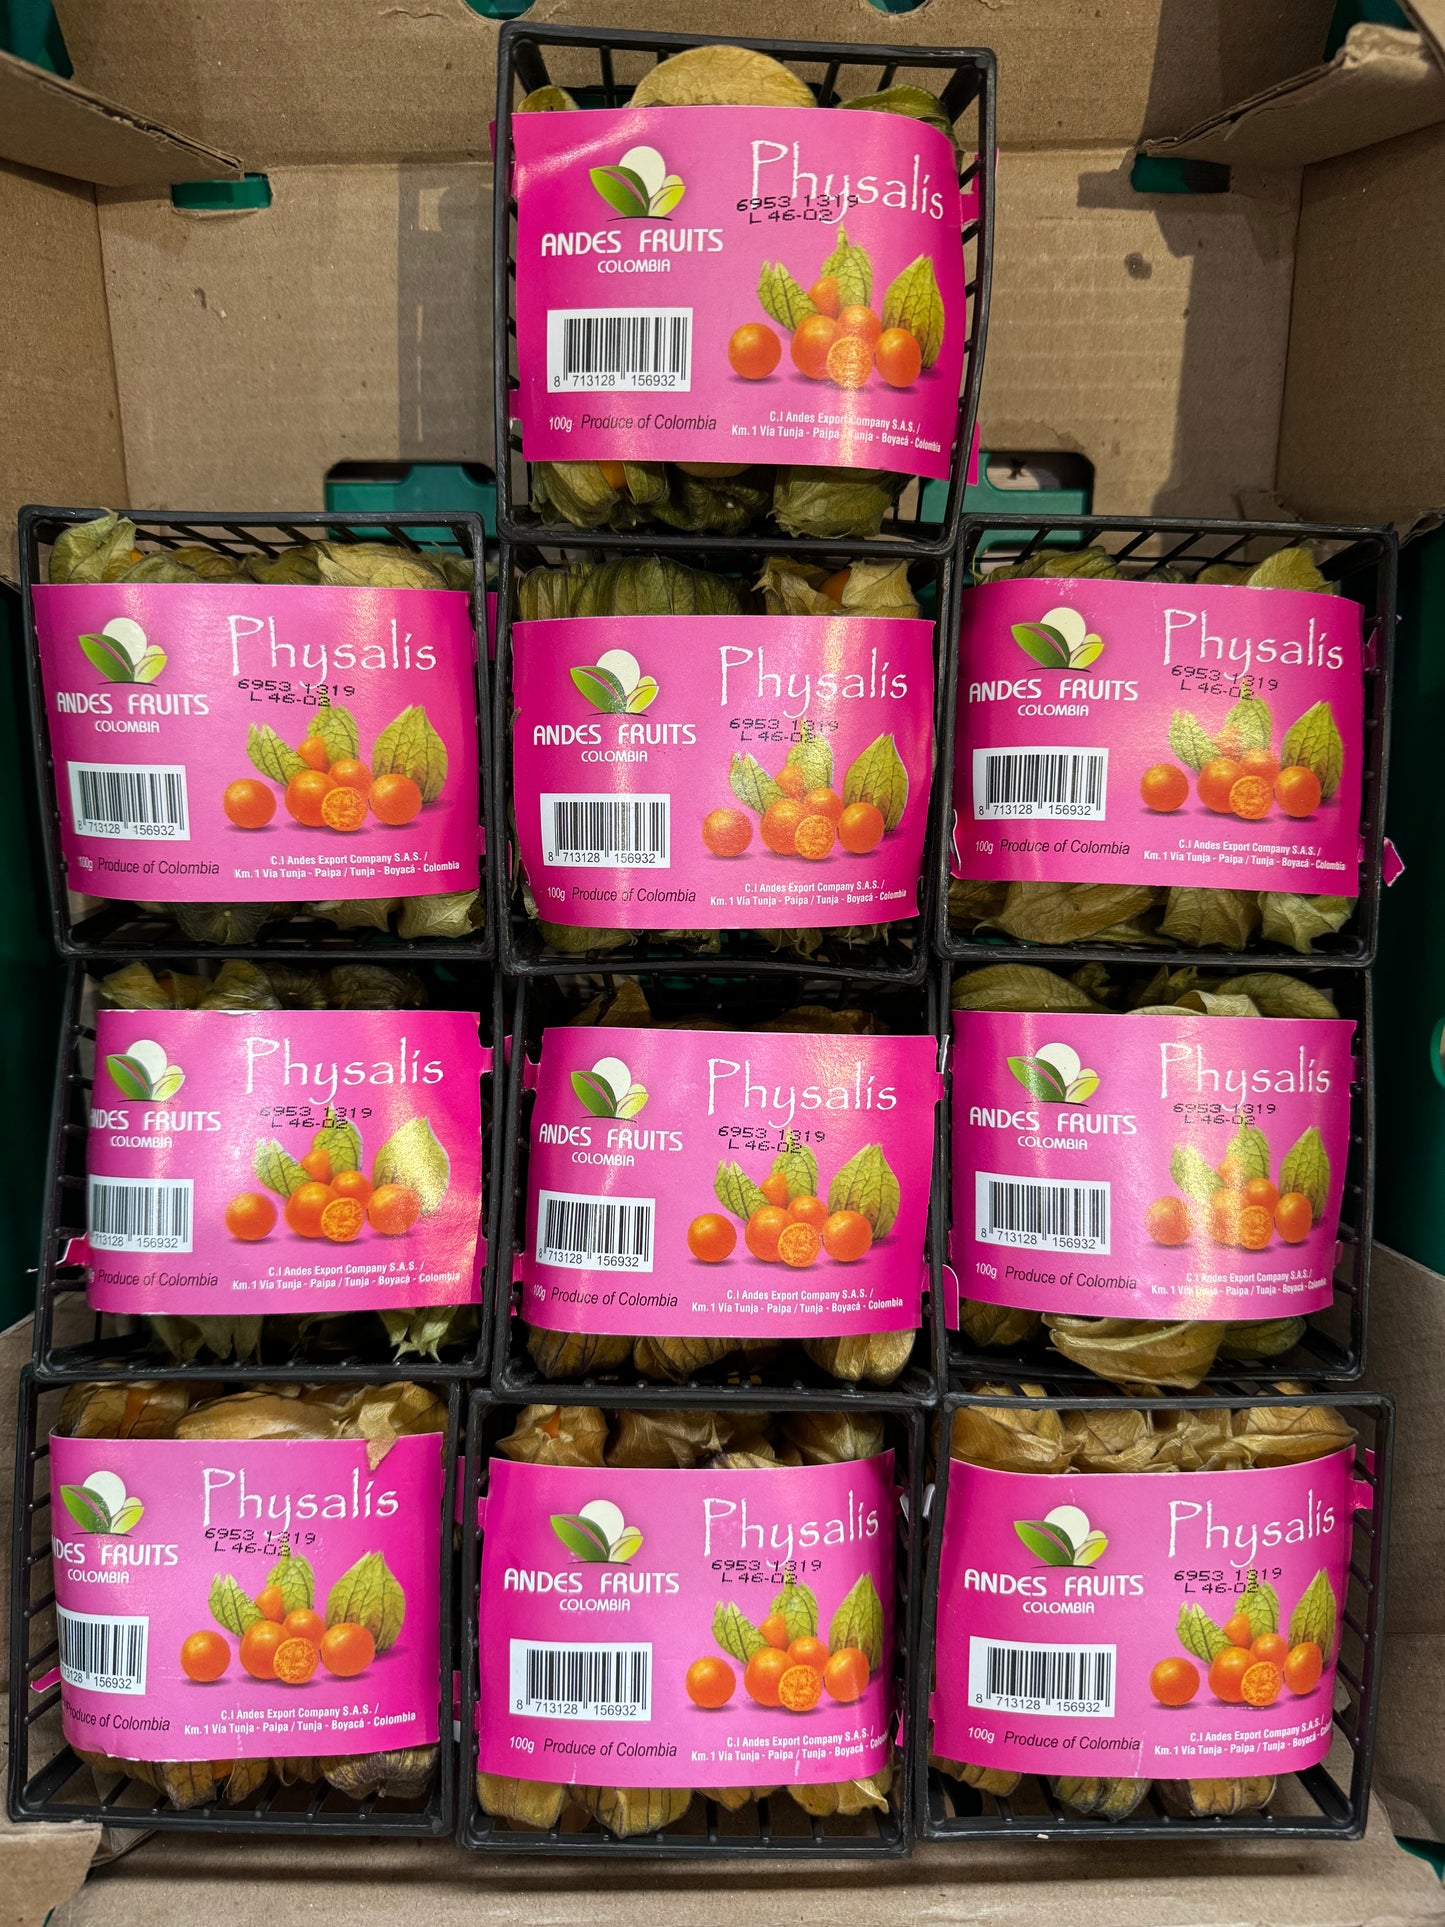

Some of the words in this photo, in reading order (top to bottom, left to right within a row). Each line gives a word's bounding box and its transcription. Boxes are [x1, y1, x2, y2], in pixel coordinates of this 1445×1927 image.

[737, 196, 791, 211] 6953
[803, 195, 859, 208] 1319
[750, 213, 761, 224] L
[768, 209, 833, 222] 46-02
[541, 231, 621, 256] ANDES
[639, 229, 723, 253] FRUITS
[598, 260, 671, 273] COLOMBIA
[573, 374, 615, 387] 713128
[632, 374, 676, 386] 156932
[548, 417, 572, 432] 100g
[581, 415, 633, 431] Produce
[637, 415, 651, 429] of
[654, 414, 717, 431] Colombia
[1171, 665, 1220, 681] 6953
[1232, 674, 1279, 690] 1319
[238, 679, 291, 691] 6953
[305, 684, 355, 696] 1319
[969, 679, 1042, 703] ANDES
[1060, 678, 1138, 701] FRUITS
[1180, 679, 1191, 690] L
[1198, 682, 1254, 700] 46-02
[57, 693, 112, 714] ANDES
[128, 694, 209, 715] FRUITS
[250, 692, 263, 702] L
[1017, 705, 1089, 717] COLOMBIA
[95, 721, 160, 733] COLOMBIA
[729, 719, 780, 730] 6953
[533, 726, 601, 746] ANDES
[618, 723, 697, 744] FRUITS
[740, 730, 751, 741] L
[581, 750, 648, 762] COLOMBIA
[993, 803, 1033, 816] 713128
[1048, 804, 1091, 816] 156932
[88, 822, 120, 834] 713128
[133, 824, 175, 836] 156932
[1000, 839, 1050, 854] Produce
[1054, 839, 1067, 852] of
[1070, 839, 1130, 855] Colombia
[288, 854, 315, 864] Andes
[319, 854, 347, 866] Export
[351, 853, 392, 865] Company
[395, 852, 421, 863] S.A.S.
[563, 851, 600, 863] 713128
[614, 852, 656, 863] 156932
[98, 858, 140, 874] Produce
[144, 859, 155, 873] of
[159, 860, 219, 874] Colombia
[547, 887, 565, 902] 100g
[572, 888, 618, 902] Produce
[621, 888, 633, 901] of
[637, 888, 696, 902] Colombia
[144, 1109, 221, 1131] FRUITS
[324, 1106, 373, 1119] 1319
[969, 1106, 1039, 1130] ANDES
[1057, 1113, 1137, 1134] FRUITS
[539, 1124, 591, 1147] ANDES
[607, 1129, 683, 1151] FRUITS
[718, 1126, 767, 1138] 6953
[779, 1129, 825, 1142] 1319
[111, 1136, 172, 1148] COLOMBIA
[728, 1139, 739, 1150] L
[745, 1140, 801, 1154] 46-02
[1017, 1136, 1088, 1150] COLOMBIA
[572, 1152, 634, 1166] COLOMBIA
[137, 1236, 178, 1248] 156932
[997, 1230, 1038, 1245] 713128
[1052, 1235, 1096, 1250] 156932
[548, 1251, 582, 1265] 713128
[597, 1254, 639, 1267] 156932
[99, 1270, 140, 1286] Produce
[143, 1272, 156, 1286] of
[158, 1271, 218, 1287] Colombia
[1005, 1266, 1056, 1286] Produce
[1059, 1271, 1073, 1287] of
[1076, 1272, 1137, 1290] Colombia
[551, 1286, 598, 1305] Produce
[602, 1290, 615, 1306] of
[618, 1290, 677, 1307] Colombia
[742, 1289, 768, 1300] Andes
[771, 1289, 798, 1301] Export
[801, 1290, 839, 1302] Company
[842, 1289, 867, 1299] S.A.S.
[692, 1302, 708, 1312] Km.
[711, 1303, 715, 1312] 1
[734, 1302, 758, 1314] Tunja
[800, 1303, 823, 1315] Tunja
[831, 1300, 859, 1313] Boyacá
[868, 1297, 903, 1309] Colombia
[205, 1528, 254, 1541] 6953
[266, 1531, 316, 1545] 1319
[214, 1541, 225, 1552] L
[101, 1544, 178, 1565] FRUITS
[712, 1559, 761, 1571] 6953
[773, 1559, 822, 1572] 1319
[67, 1570, 129, 1583] COLOMBIA
[504, 1568, 582, 1592] ANDES
[601, 1572, 680, 1593] FRUITS
[721, 1573, 732, 1583] L
[964, 1569, 1047, 1596] ANDES
[1065, 1574, 1144, 1596] FRUITS
[1174, 1569, 1223, 1582] 6953
[1235, 1568, 1282, 1580] 1319
[1184, 1583, 1195, 1593] L
[1201, 1582, 1258, 1594] 46-02
[560, 1599, 630, 1611] COLOMBIA
[1023, 1601, 1095, 1614] COLOMBIA
[93, 1676, 132, 1689] 156932
[237, 1708, 264, 1718] Andes
[267, 1708, 295, 1719] Export
[298, 1706, 339, 1718] Company
[343, 1705, 371, 1716] S.A.S.
[535, 1701, 578, 1715] 713128
[593, 1704, 637, 1716] 156932
[996, 1696, 1041, 1710] 713128
[1056, 1700, 1100, 1713] 156932
[65, 1704, 96, 1727] Produce
[99, 1714, 110, 1728] of
[113, 1714, 170, 1731] Colombia
[509, 1736, 534, 1753] 100g
[544, 1738, 596, 1755] Produce
[600, 1740, 613, 1756] of
[616, 1740, 677, 1758] Colombia
[967, 1727, 995, 1743] 100g
[1004, 1731, 1059, 1749] Produce
[1062, 1735, 1076, 1749] of
[1080, 1736, 1140, 1752] Colombia
